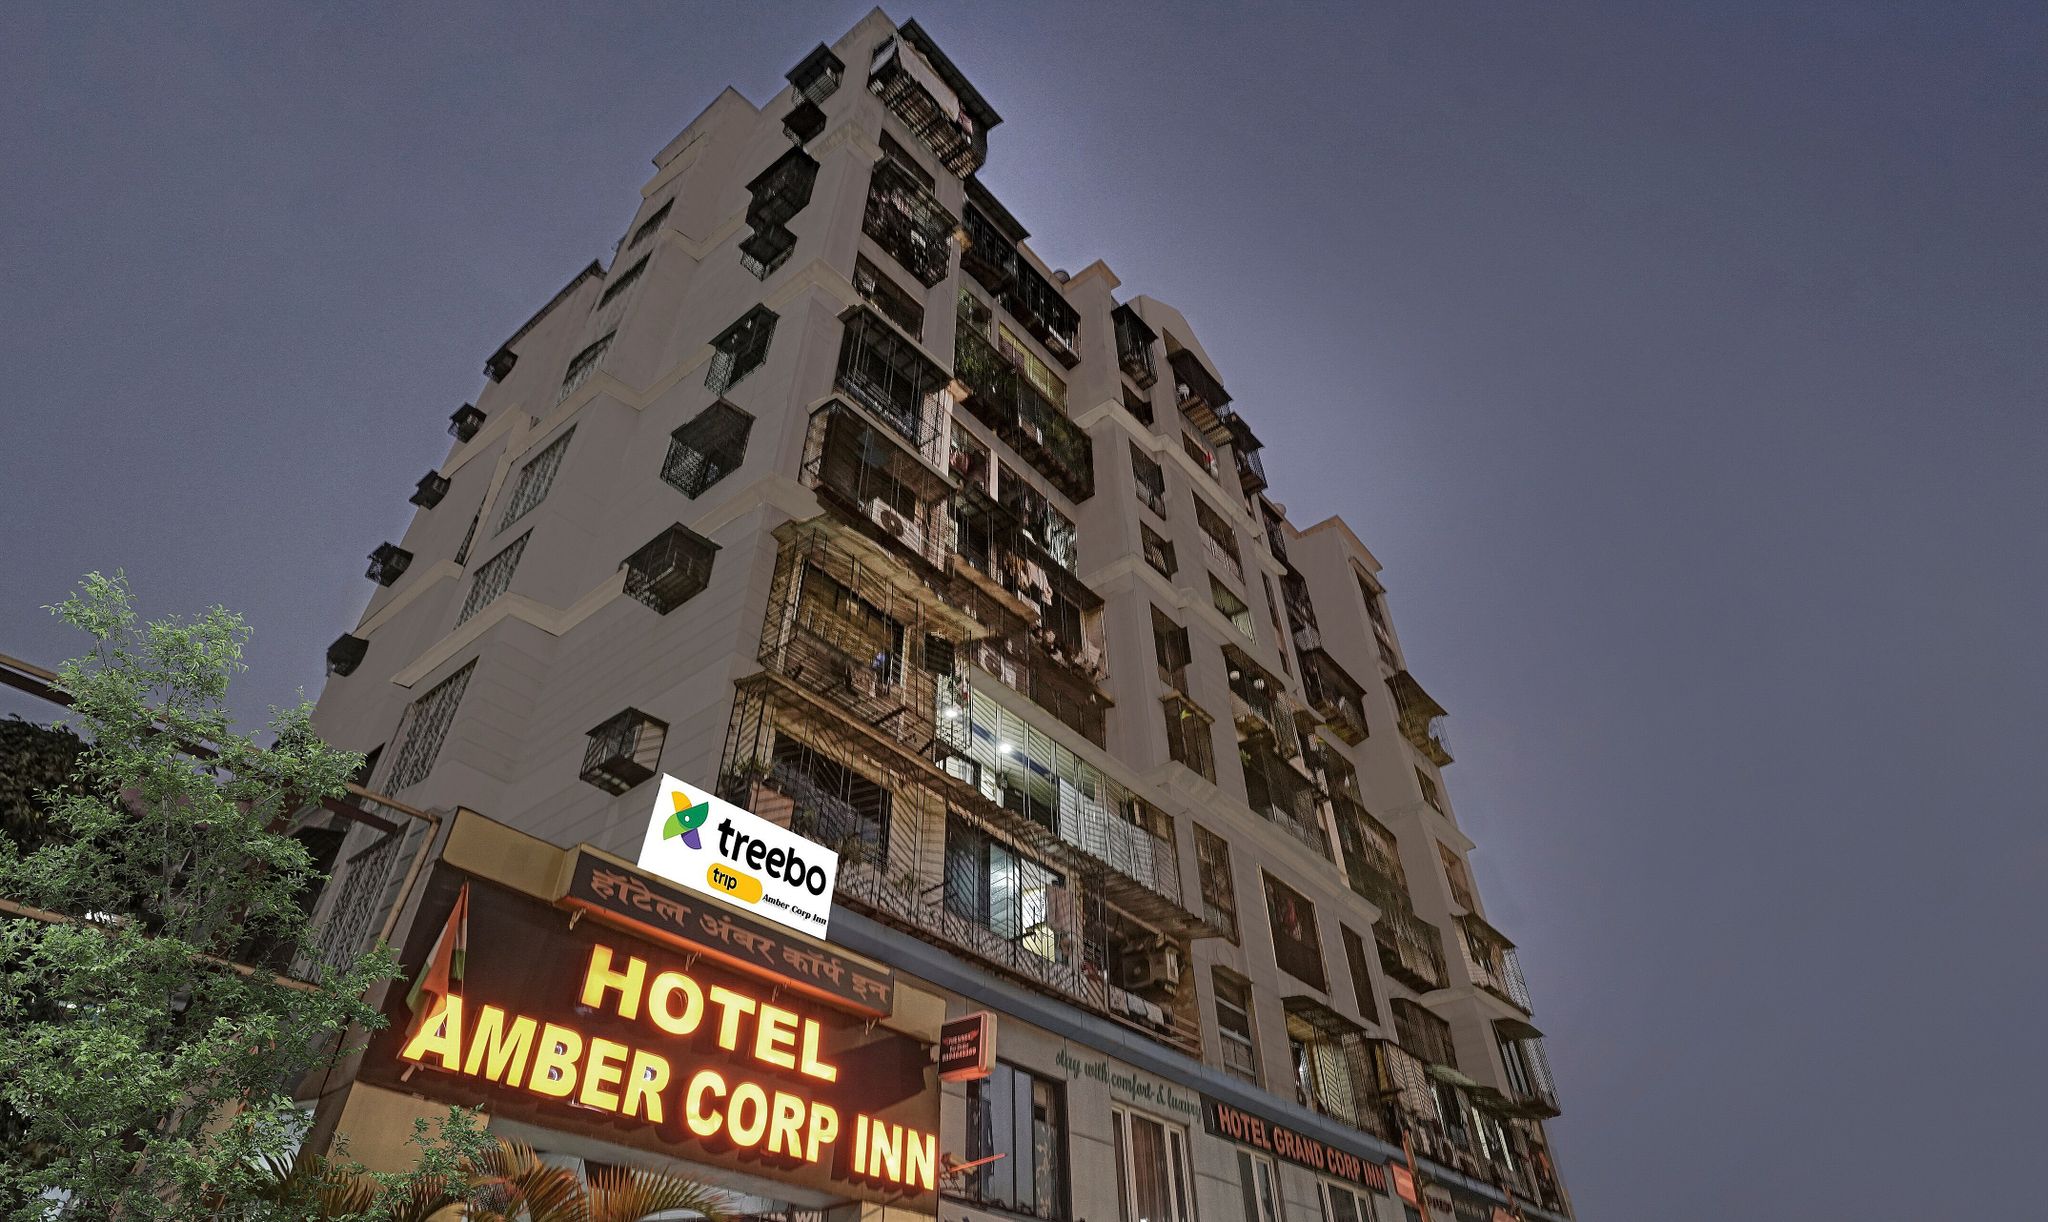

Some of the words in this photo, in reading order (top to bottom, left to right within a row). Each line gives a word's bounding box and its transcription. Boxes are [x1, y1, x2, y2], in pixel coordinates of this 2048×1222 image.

[713, 867, 738, 891] trip
[717, 818, 826, 896] treebo
[762, 893, 790, 912] Amber
[791, 905, 812, 920] Corp
[812, 913, 827, 926] Inn
[699, 913, 776, 966] अंबर
[851, 972, 891, 1004] इन
[580, 943, 837, 1083] HOTEL
[402, 993, 671, 1124] AMBER
[685, 1068, 840, 1163] CORP
[853, 1112, 937, 1191] INN
[1156, 1084, 1166, 1105] &
[1217, 1103, 1272, 1151] HOTEL
[1273, 1126, 1325, 1170] GRAND
[1326, 1146, 1361, 1183] CORP
[1362, 1159, 1388, 1192] INN
